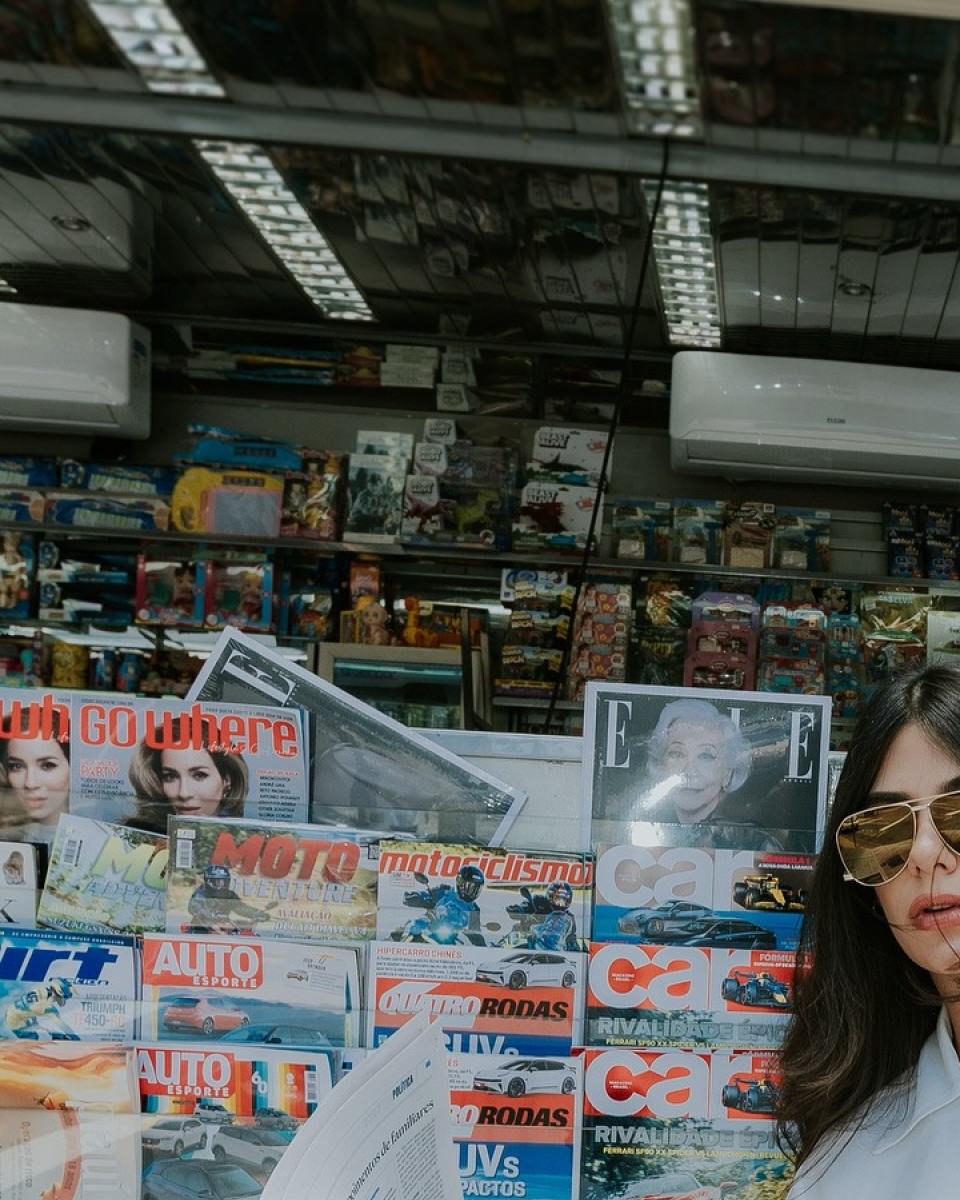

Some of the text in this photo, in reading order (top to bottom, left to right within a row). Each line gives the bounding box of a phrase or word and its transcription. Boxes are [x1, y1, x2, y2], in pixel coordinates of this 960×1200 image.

[79, 703, 299, 758] GO where
[211, 832, 361, 883] MOTO
[153, 943, 260, 977] AUTO
[377, 947, 430, 957] HIPERCARRO
[193, 976, 258, 989] ESPORTE
[588, 944, 752, 1011] car
[81, 1002, 126, 1015] TRIUMPH
[379, 990, 569, 1020] QUATRO RODAS
[598, 1018, 733, 1040] RIVALIDADE
[137, 1050, 232, 1087] AUTO
[168, 1084, 230, 1098] ESPORTE
[392, 1075, 413, 1100] POLÍTICA
[586, 1050, 752, 1119] car
[390, 1100, 434, 1144] familiares
[477, 1105, 569, 1128] RODAS
[595, 1125, 733, 1148] RIVALIDADE
